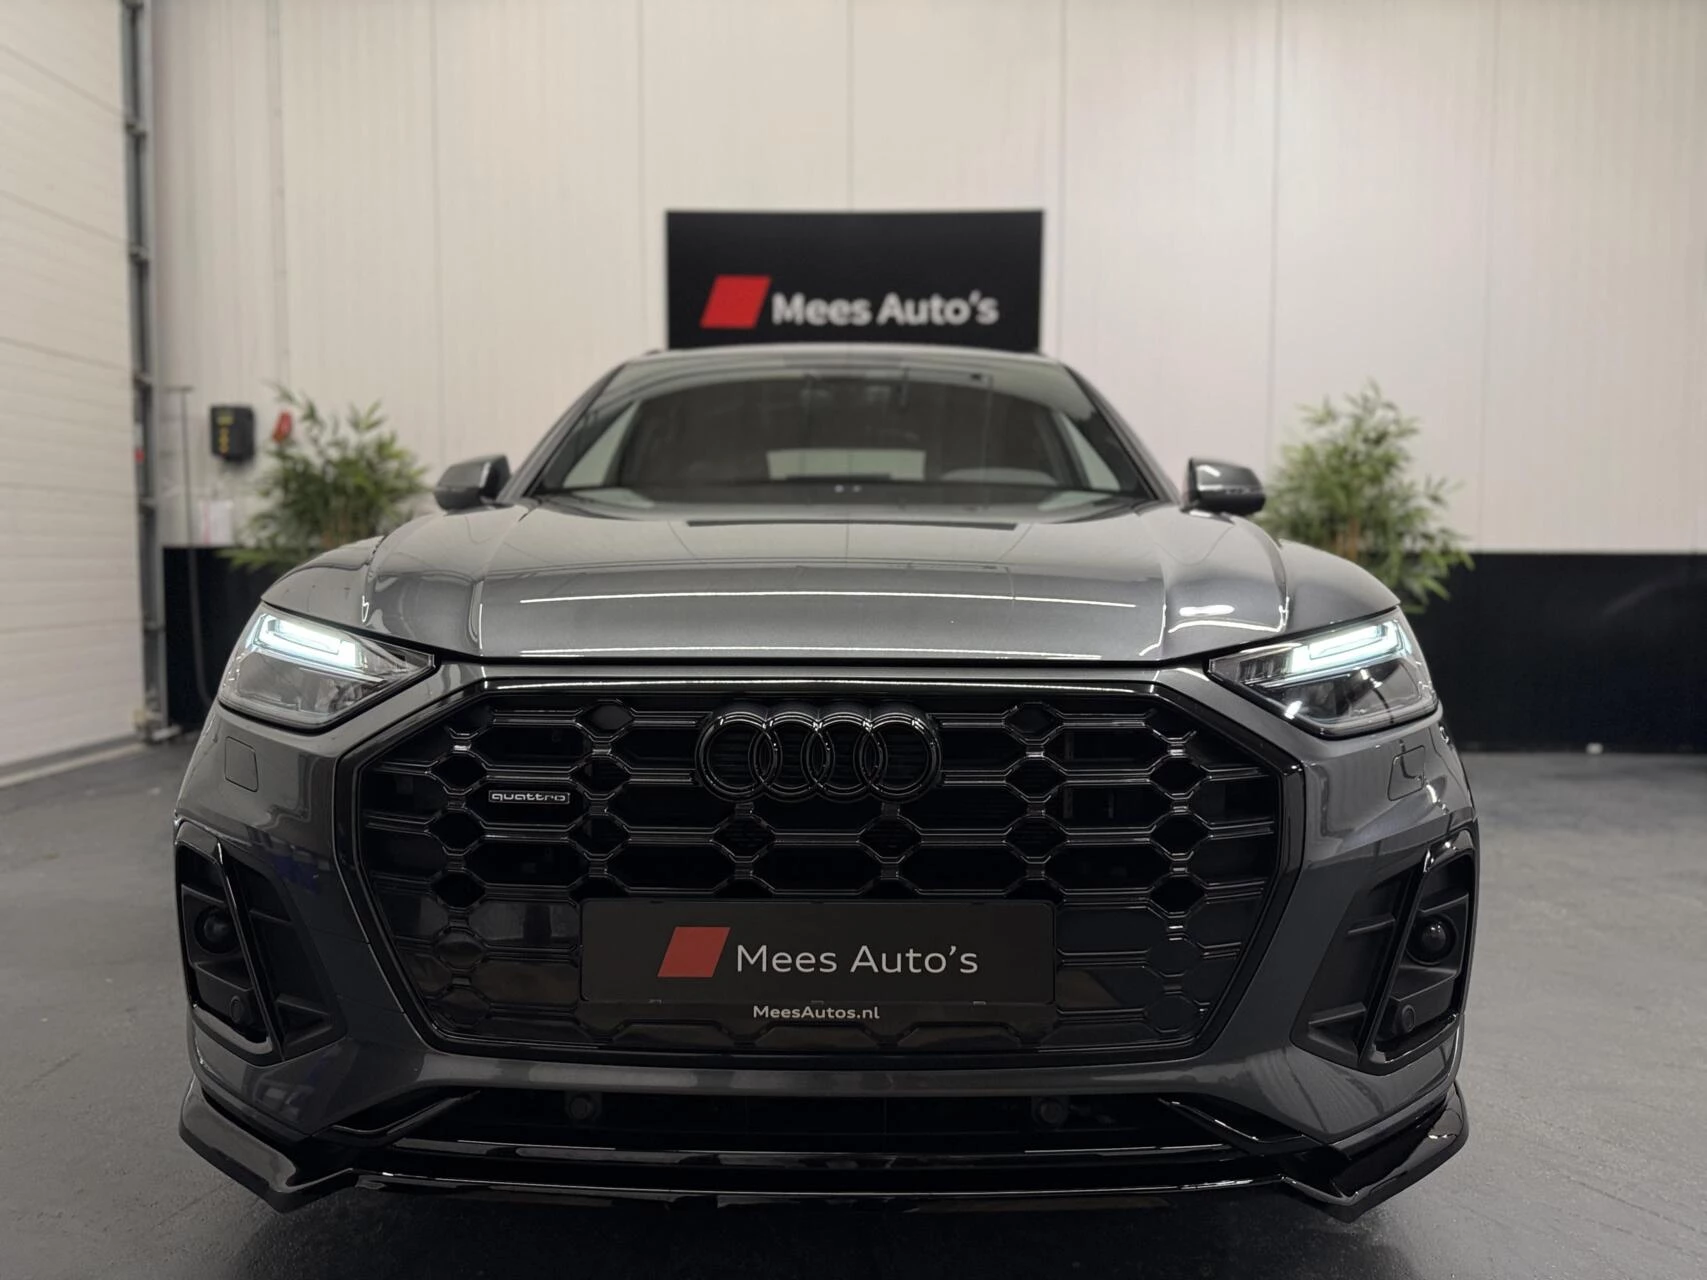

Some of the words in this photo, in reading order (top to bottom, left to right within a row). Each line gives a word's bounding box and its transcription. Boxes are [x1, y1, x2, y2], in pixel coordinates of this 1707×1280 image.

[772, 292, 872, 326] Mees
[876, 290, 999, 326] Auto's
[491, 792, 566, 802] quattro
[737, 945, 838, 973] Mees
[850, 945, 978, 973] Auto's
[753, 1005, 880, 1020] MeesAutos.nl
